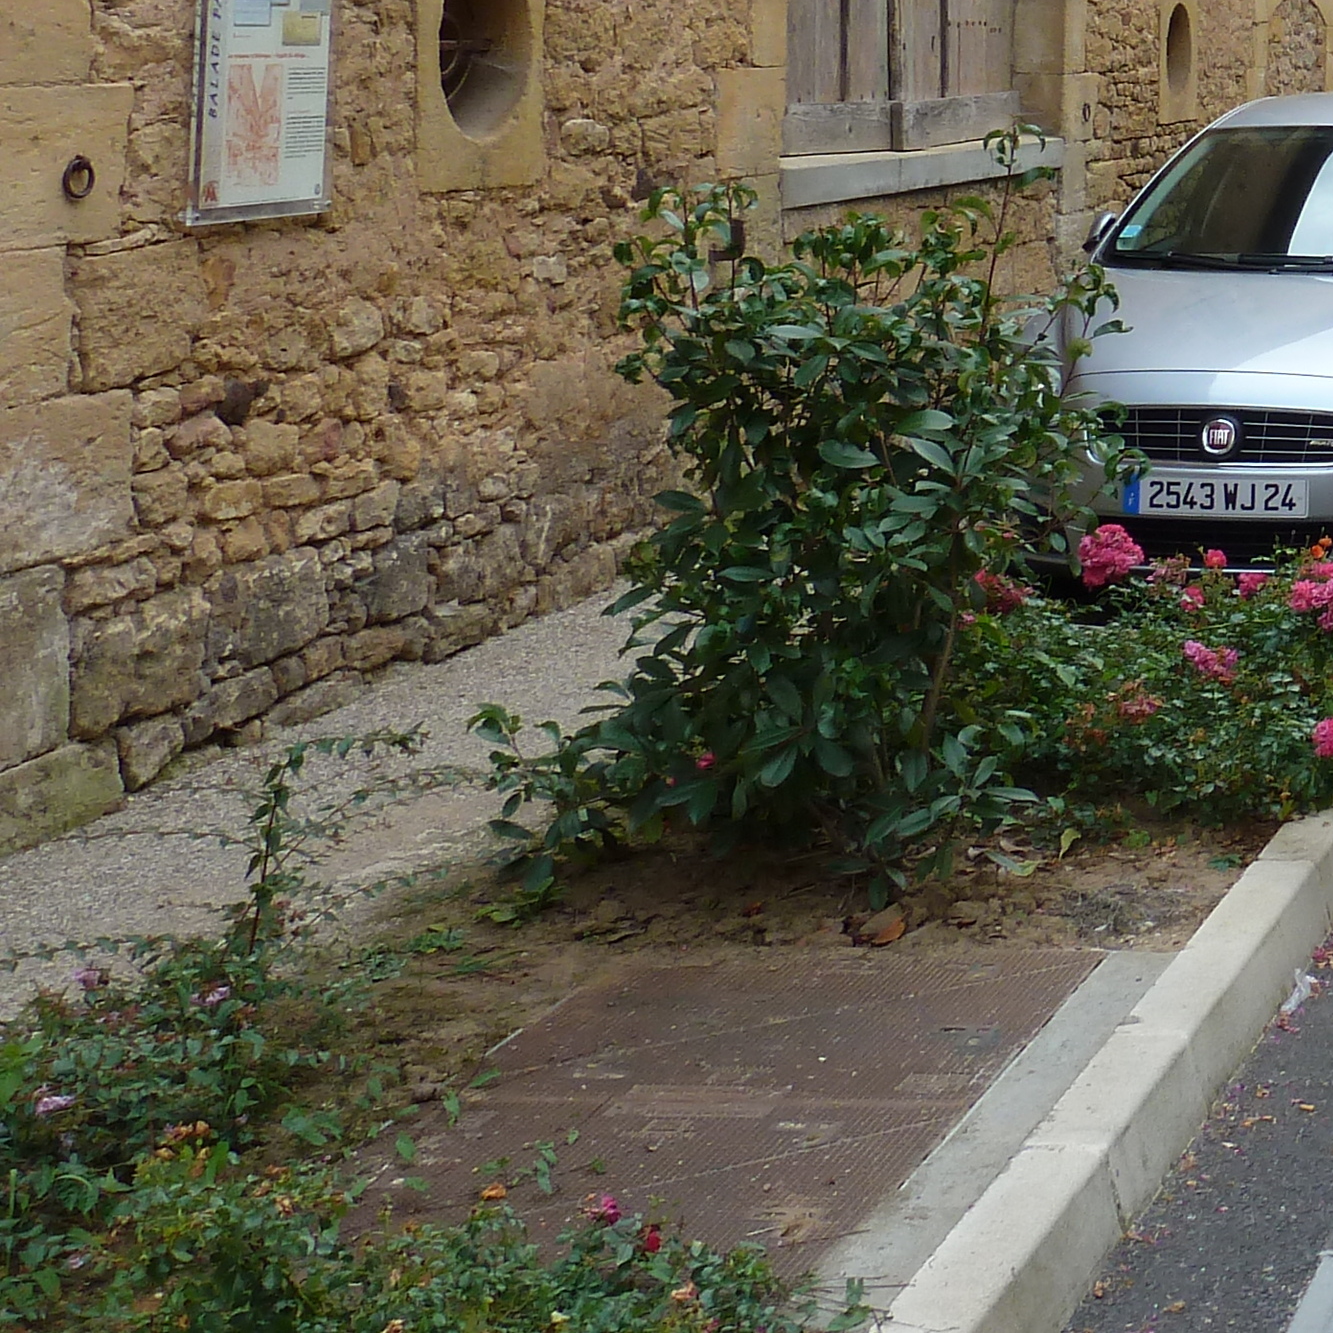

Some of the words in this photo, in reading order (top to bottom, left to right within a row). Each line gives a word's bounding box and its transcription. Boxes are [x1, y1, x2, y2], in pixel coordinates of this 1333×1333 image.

[207, 32, 221, 118] BALADE
[1209, 429, 1230, 446] FIAT
[1149, 480, 1215, 510] 2543
[1223, 482, 1256, 511] WJ
[1263, 483, 1297, 511] 24
